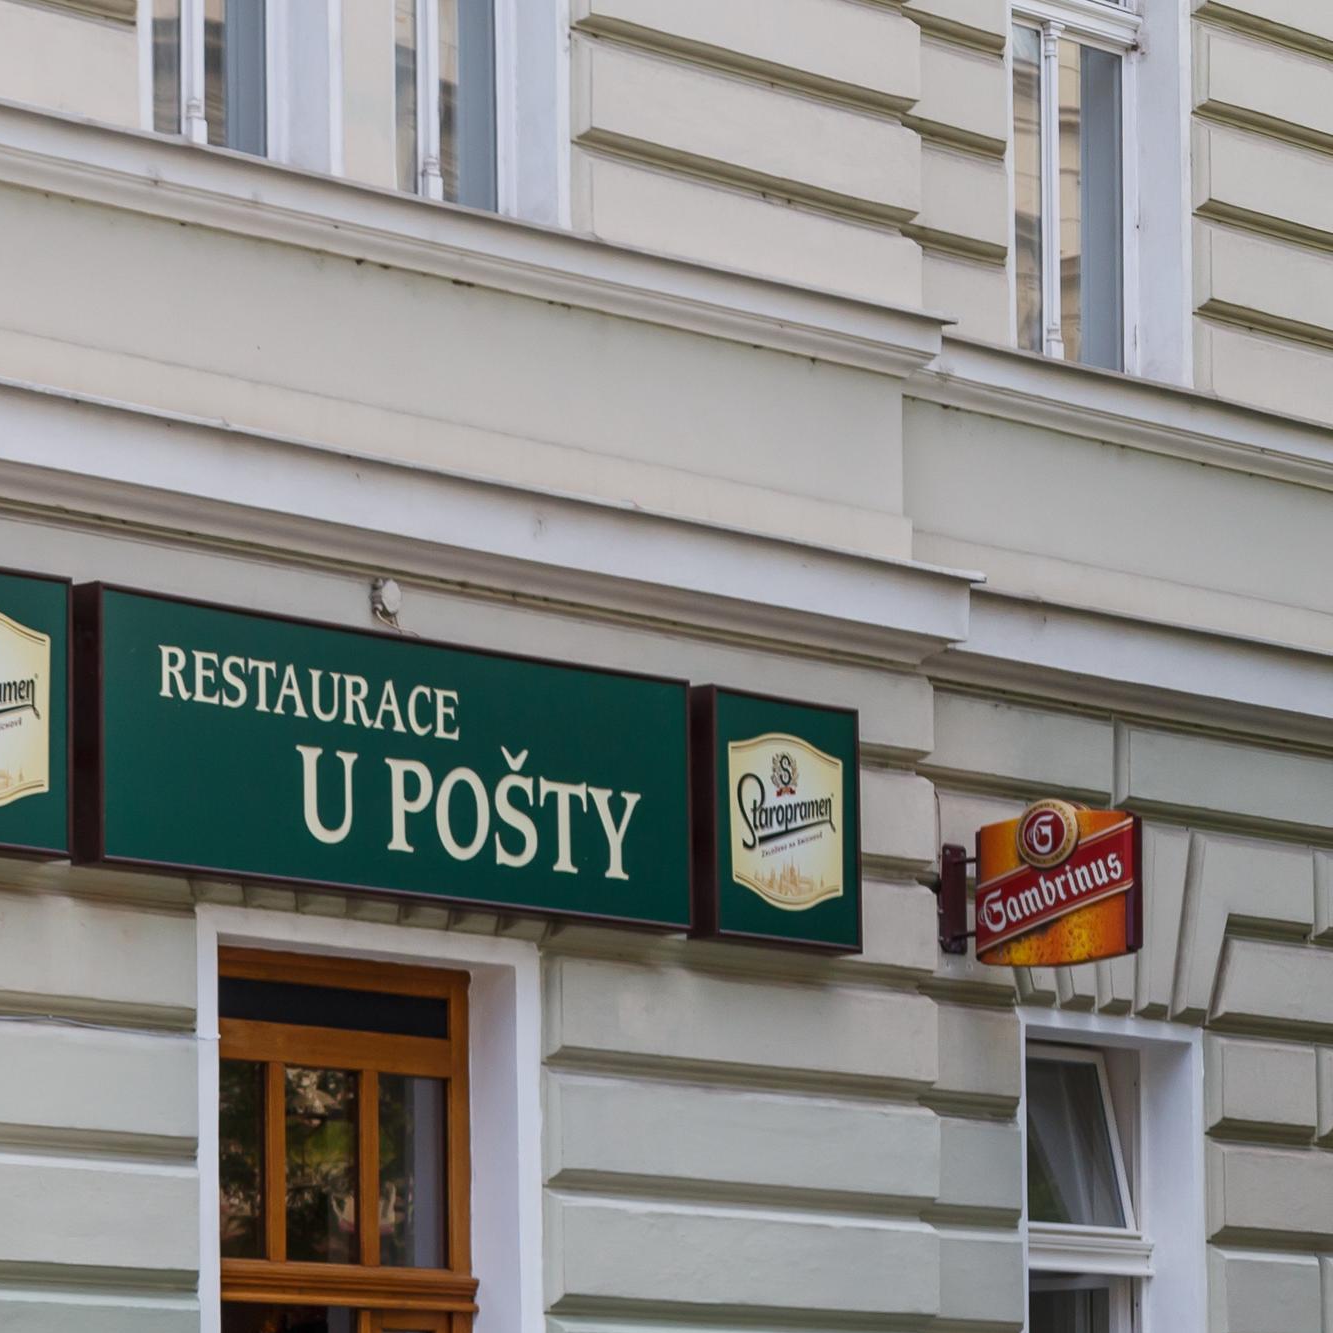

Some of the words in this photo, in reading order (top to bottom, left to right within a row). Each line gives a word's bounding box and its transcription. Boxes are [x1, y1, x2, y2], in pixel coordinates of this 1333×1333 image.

[157, 644, 460, 741] RESTAURACE
[295, 744, 358, 845] U
[384, 746, 641, 881] POŠTY
[737, 773, 836, 850] Staropramen
[978, 852, 1123, 933] Gambrinus
